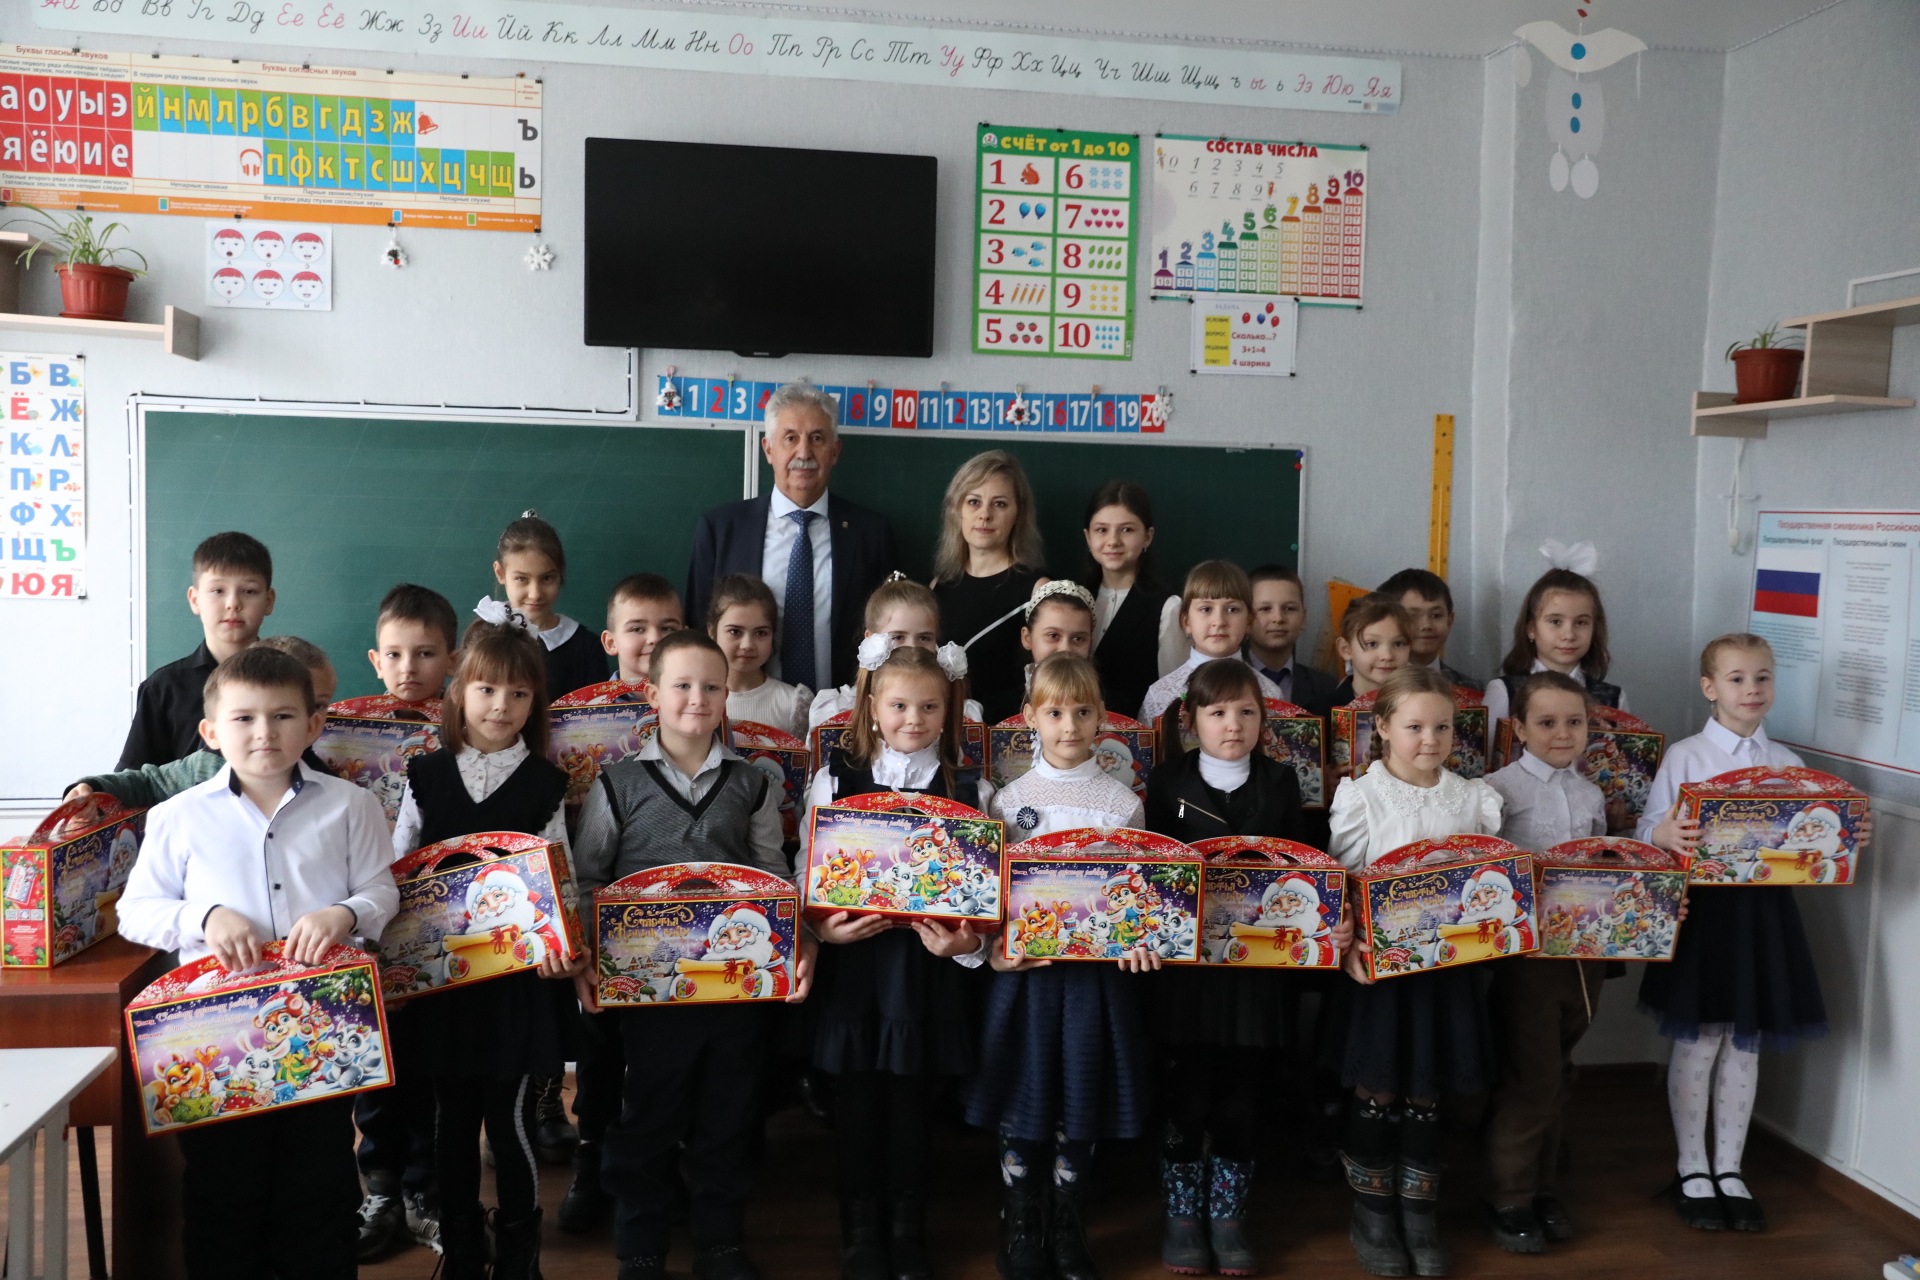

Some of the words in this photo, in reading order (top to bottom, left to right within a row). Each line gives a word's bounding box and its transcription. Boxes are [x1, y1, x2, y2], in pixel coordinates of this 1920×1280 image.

[16, 46, 44, 56] Буквы
[45, 48, 78, 58] гласных
[80, 51, 109, 61] звуков
[226, 2, 264, 34] Дд
[276, 3, 304, 26] Ее
[317, 3, 345, 29] Ёё
[359, 10, 404, 33] Жж
[418, 14, 443, 43] Зз
[452, 15, 488, 39] Ии
[497, 14, 533, 41] Йй
[542, 21, 578, 44] Кк
[588, 25, 623, 47] Лл
[631, 27, 676, 50] Мм
[685, 30, 720, 53] Нн
[728, 33, 754, 56] Оо
[767, 34, 803, 57] Пп
[813, 36, 842, 68] Рр
[851, 39, 874, 61] Сс
[883, 41, 931, 65] Тт
[940, 45, 965, 77] Уу
[972, 47, 1004, 77] Фф
[1011, 51, 1043, 72] Хх
[1051, 55, 1081, 79] Цц
[1095, 58, 1121, 80] Чч
[1132, 62, 1171, 83] Шш
[1181, 66, 1219, 90] Щщ
[1293, 73, 1313, 93] Ээ
[1322, 75, 1354, 96] Юю
[1363, 77, 1392, 99] Яя
[262, 63, 287, 73] Буквы
[288, 66, 329, 76] согласных
[330, 68, 357, 77] звуков
[1000, 134, 1047, 152] СЧЁТ
[1071, 139, 1081, 154] 1
[1107, 142, 1130, 156] 10
[1206, 140, 1263, 155] СОСТАВ
[1267, 144, 1318, 158] ЧИСЛА
[990, 160, 1006, 185] 1
[1065, 164, 1083, 189] 6
[988, 199, 1005, 225] 2
[1065, 204, 1082, 229] 7
[1159, 250, 1168, 269] 1
[1180, 242, 1192, 260] 2
[1201, 232, 1215, 251] 3
[1221, 221, 1235, 241] 4
[1243, 211, 1256, 231] 5
[1263, 206, 1277, 223] 6
[1286, 197, 1300, 215] 7
[1307, 185, 1320, 205] 8
[1328, 178, 1340, 197] 9
[1344, 170, 1364, 187] 10
[987, 239, 1004, 264] 3
[1063, 243, 1081, 268] 8
[985, 279, 1004, 305] 4
[1063, 283, 1081, 308] 9
[985, 318, 1002, 343] 5
[1058, 322, 1091, 348] 10
[10, 362, 31, 385] Б
[49, 364, 70, 386] В
[1239, 360, 1270, 368] шарика
[11, 392, 30, 420] Ё
[49, 399, 81, 422] Ж
[688, 385, 698, 411] 1
[710, 386, 724, 413] 2
[734, 387, 747, 414] 3
[850, 394, 864, 420] 8
[874, 395, 887, 421] 9
[895, 396, 915, 423] 10
[920, 398, 938, 423] 11
[945, 398, 965, 424] 12
[970, 399, 990, 425] 13
[1046, 400, 1067, 426] 16
[1070, 400, 1090, 426] 17
[1094, 401, 1115, 426] 18
[1118, 401, 1138, 427] 19
[10, 432, 32, 455] К
[49, 434, 72, 457] Л
[10, 467, 31, 490] П
[49, 469, 70, 491] Р
[10, 501, 35, 526] Ф
[50, 504, 74, 527] Х
[12, 538, 47, 563] Щ
[50, 539, 77, 561] Ъ
[12, 573, 46, 595] Ю
[51, 574, 73, 596] Я
